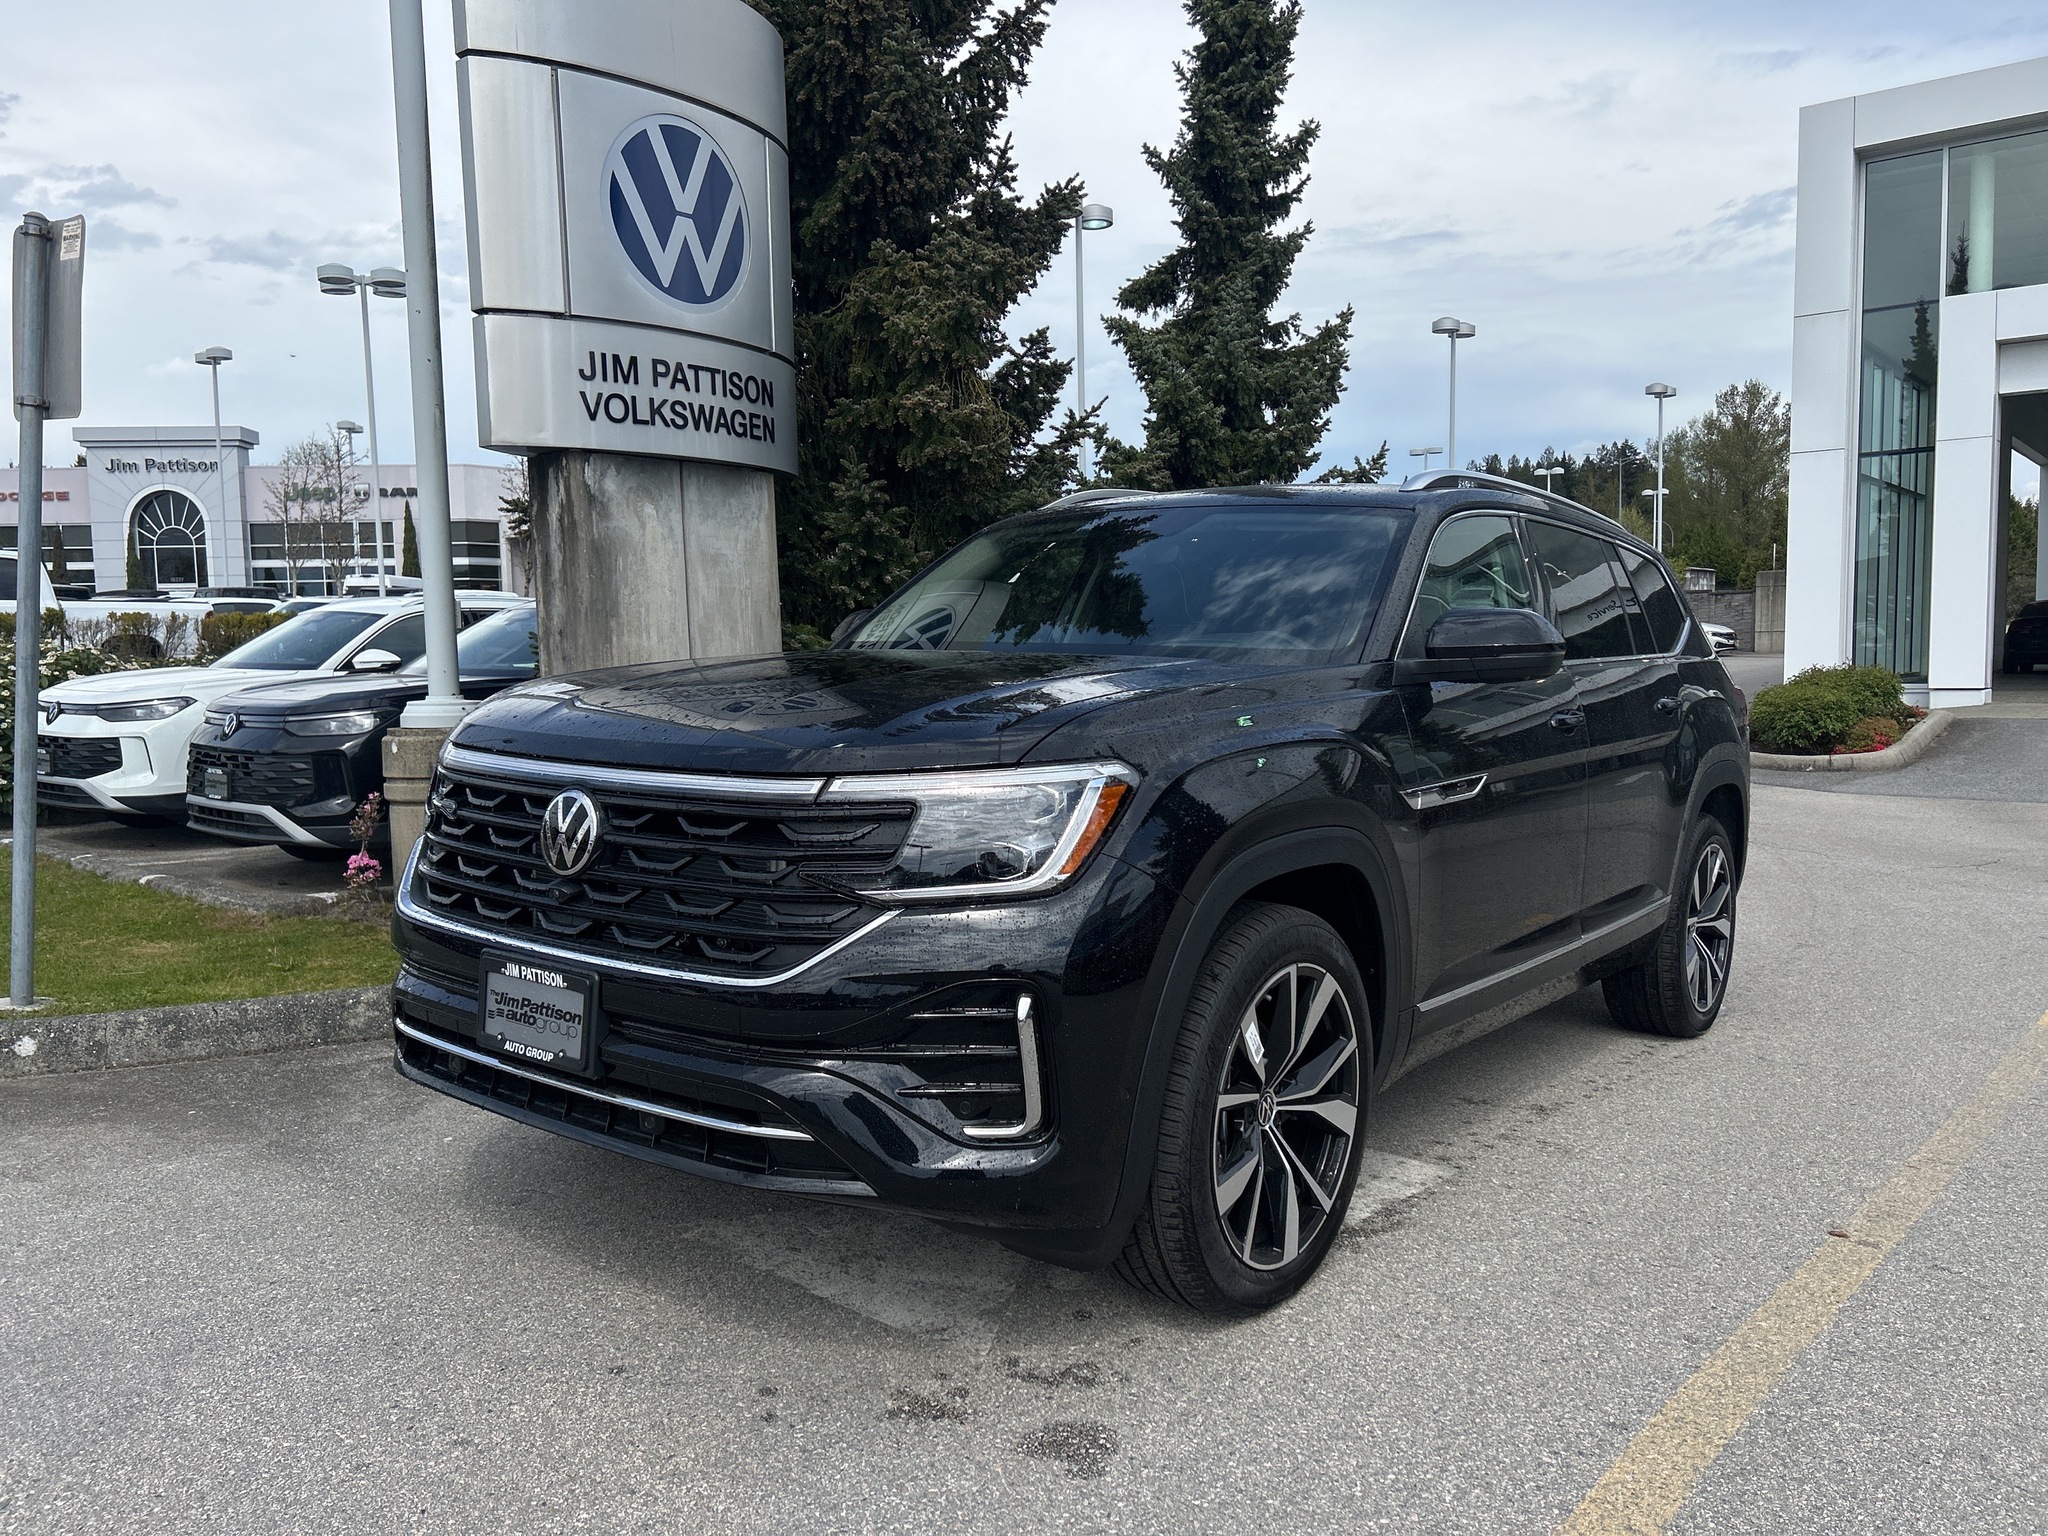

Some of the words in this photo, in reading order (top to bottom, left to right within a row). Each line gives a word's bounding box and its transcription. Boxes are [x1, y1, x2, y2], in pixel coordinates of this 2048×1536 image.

[578, 351, 639, 385] JIM
[652, 358, 774, 408] PATTISON
[579, 391, 775, 443] VOLKSWAGEN
[105, 459, 139, 473] Jim
[145, 458, 219, 473] Pattison
[0, 491, 70, 501] DOGE
[505, 963, 519, 978] JIM
[521, 965, 563, 988] PATTISON
[490, 989, 500, 997] The
[504, 1041, 525, 1055] AUTO
[526, 1047, 554, 1062] GROUP
